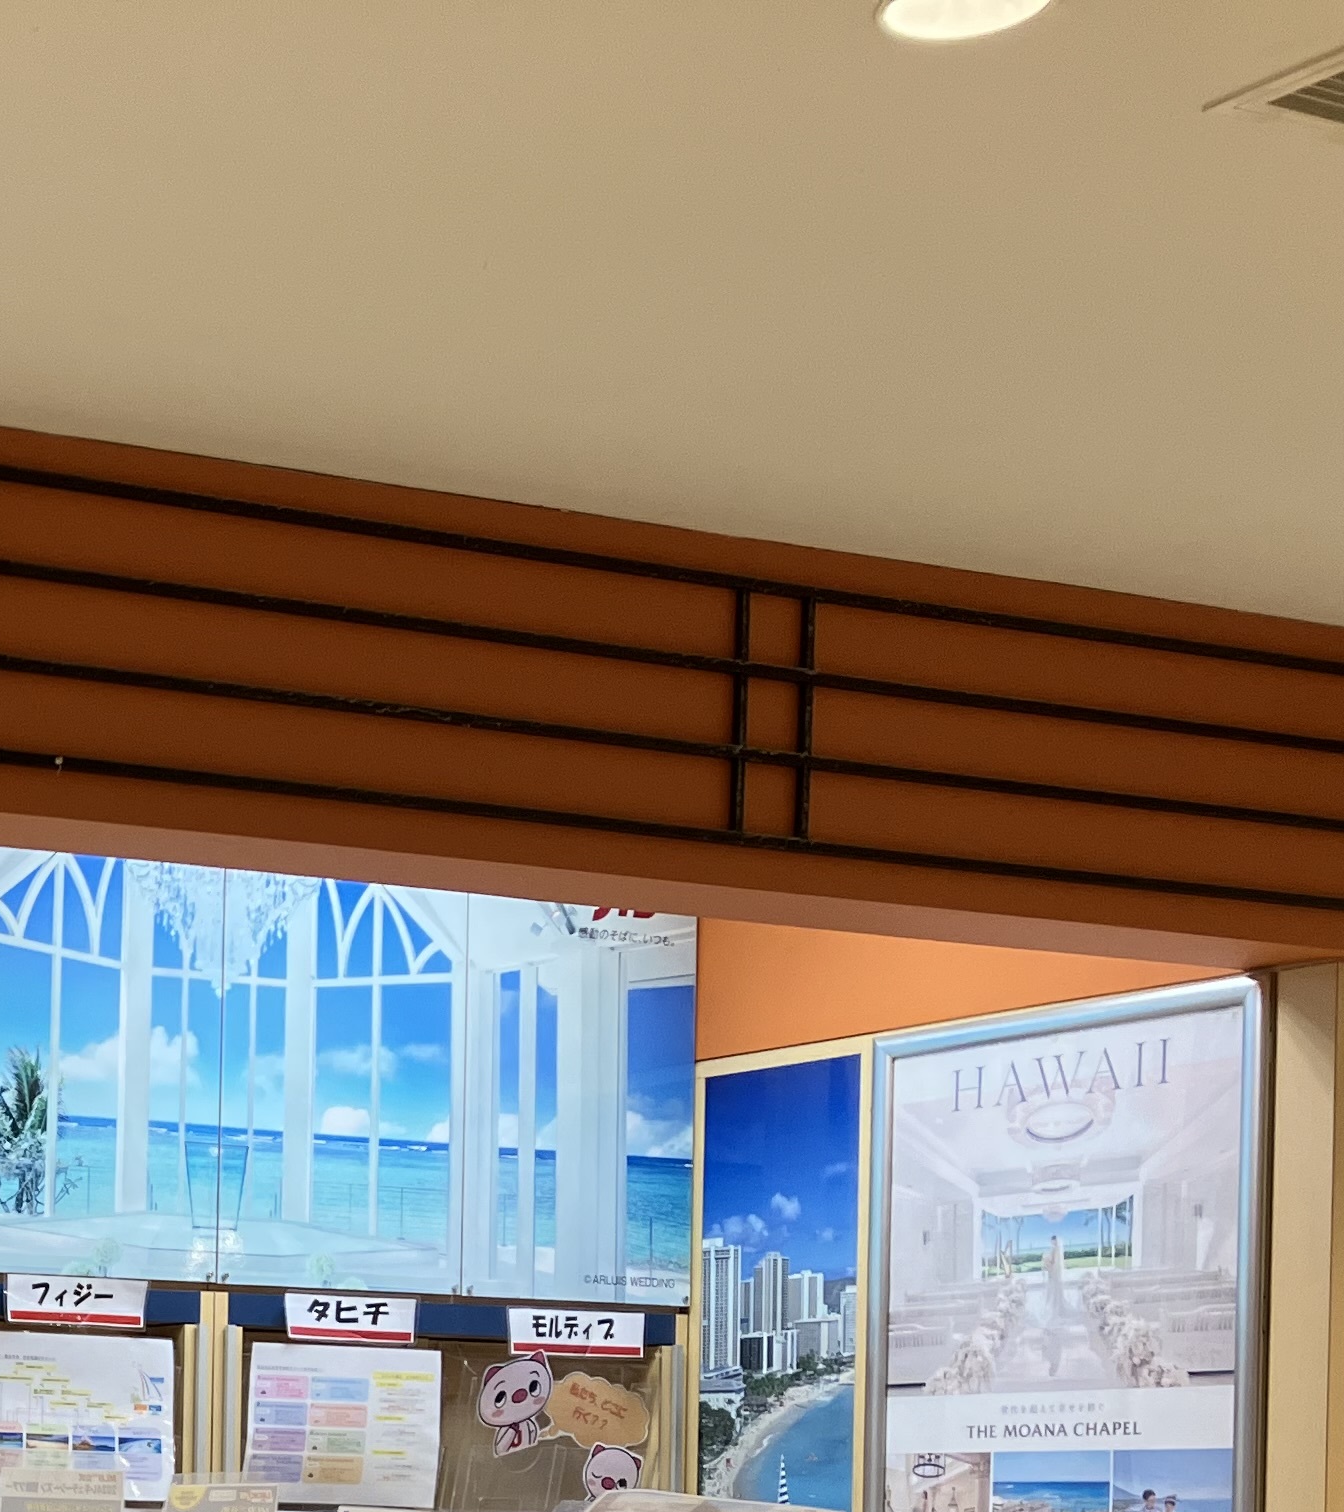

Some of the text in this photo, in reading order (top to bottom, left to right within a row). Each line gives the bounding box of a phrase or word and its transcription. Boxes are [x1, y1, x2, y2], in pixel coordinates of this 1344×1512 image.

[578, 927, 675, 946] 感動のそばに、いつも。
[951, 1037, 1172, 1112] HAWAII
[32, 1282, 113, 1307] フィジー
[630, 1276, 675, 1288] WEDDING
[308, 1300, 389, 1326] タヒチ
[532, 1315, 614, 1340] モルディブ
[966, 1421, 1142, 1440] THE MOANA CHAPEL
